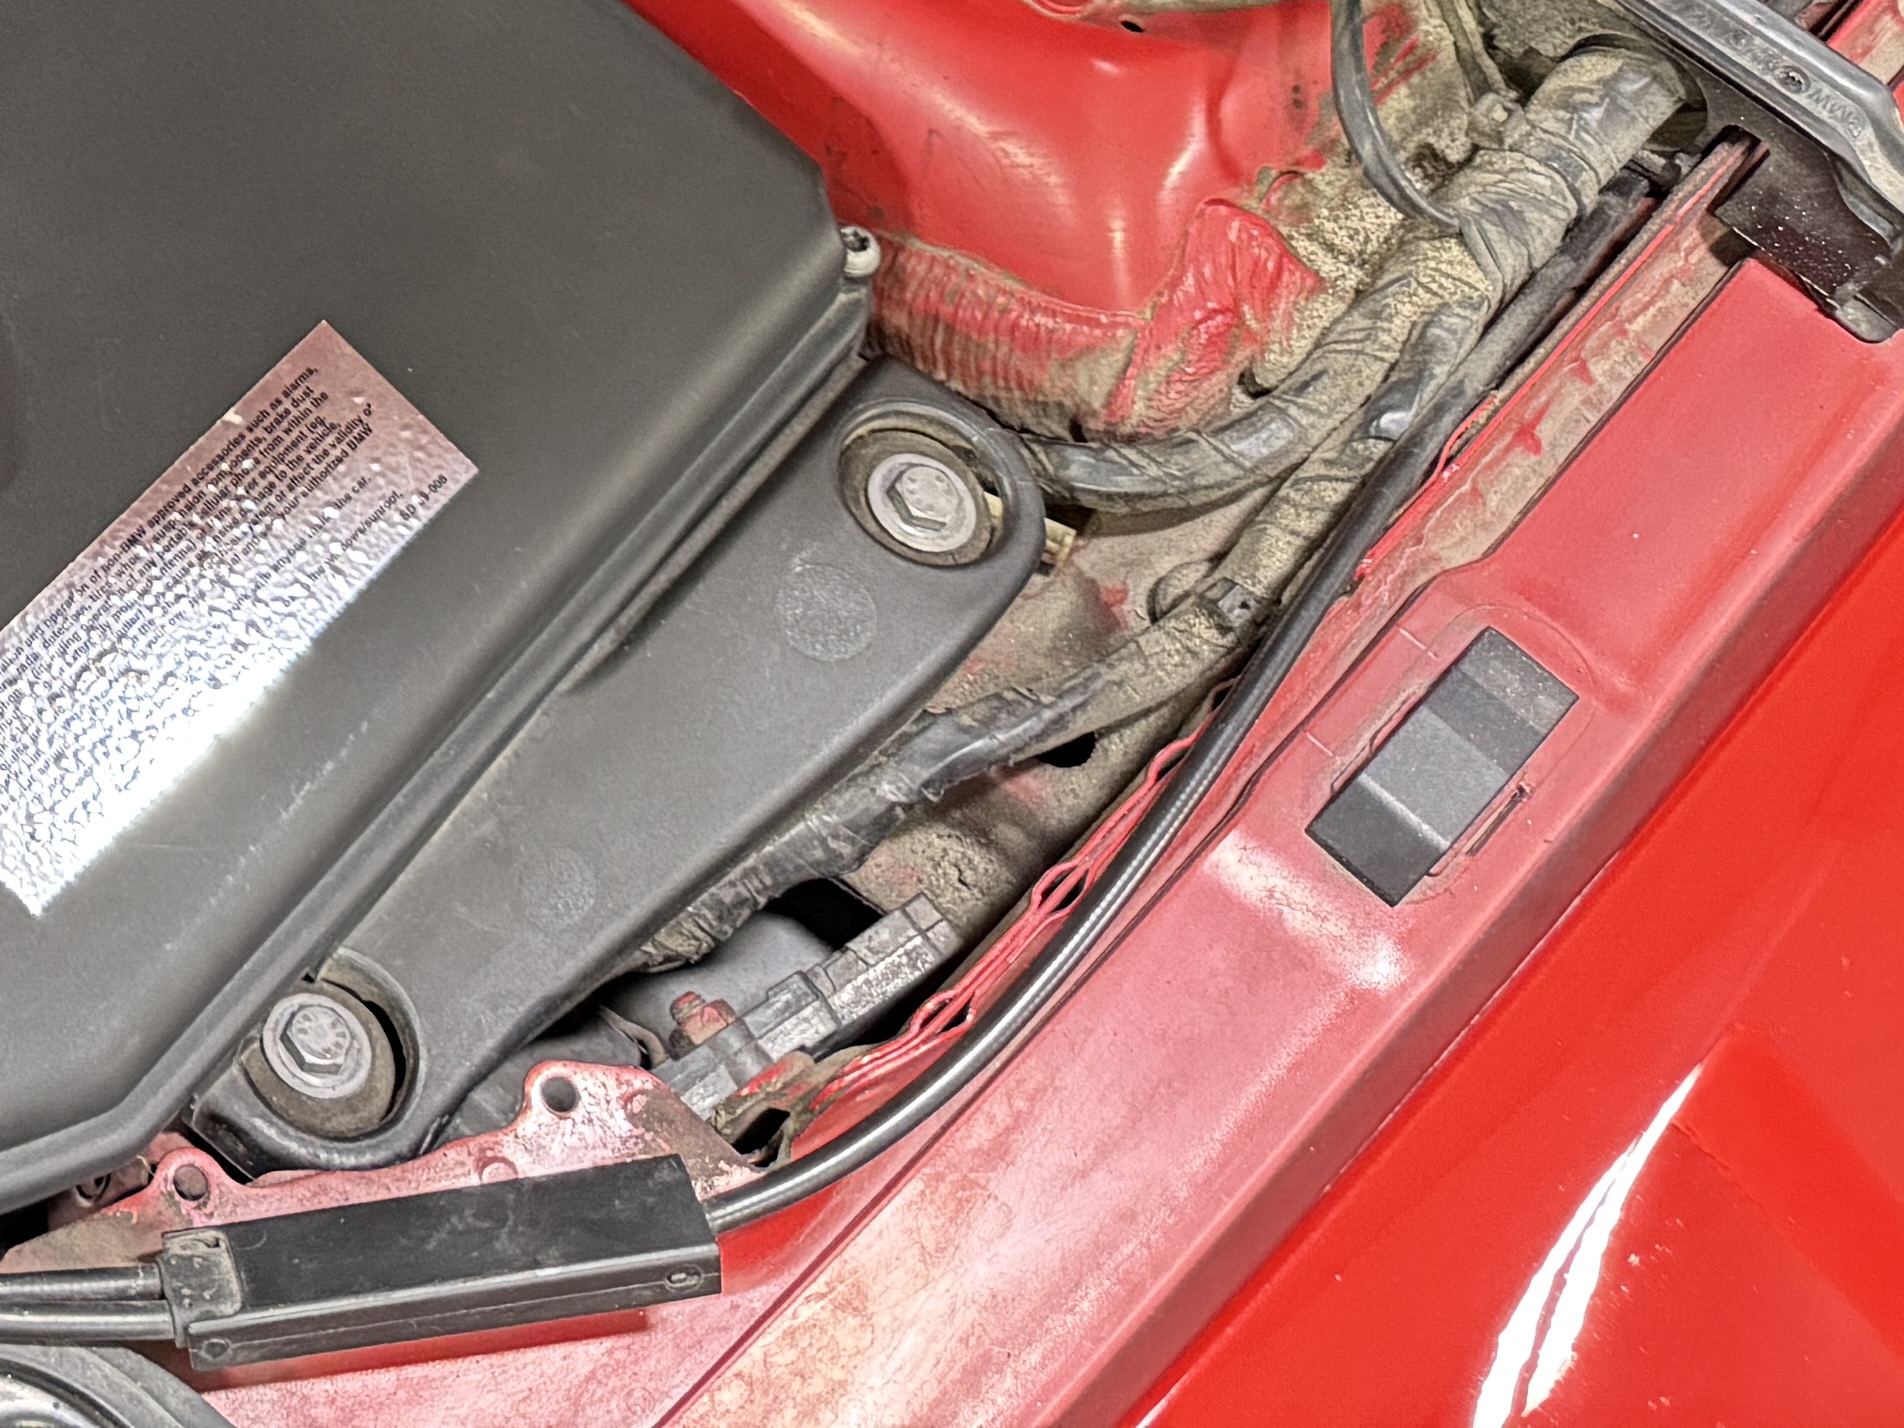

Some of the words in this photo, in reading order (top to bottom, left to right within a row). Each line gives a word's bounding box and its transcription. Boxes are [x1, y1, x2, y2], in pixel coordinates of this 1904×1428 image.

[258, 432, 283, 457] from
[281, 404, 312, 435] within
[309, 389, 328, 407] the
[262, 405, 292, 434] brake
[288, 383, 314, 409] dust
[145, 482, 193, 530] approved
[189, 430, 246, 486] accessories
[243, 407, 270, 433] such
[268, 396, 283, 410] as
[279, 362, 318, 399] alarms,
[255, 429, 309, 481] equipment
[274, 468, 289, 482] to
[285, 451, 305, 471] the
[302, 417, 341, 456] vehicle,
[310, 445, 330, 465] the
[327, 413, 366, 452] validity
[297, 447, 349, 497] authorized
[334, 490, 352, 508] the
